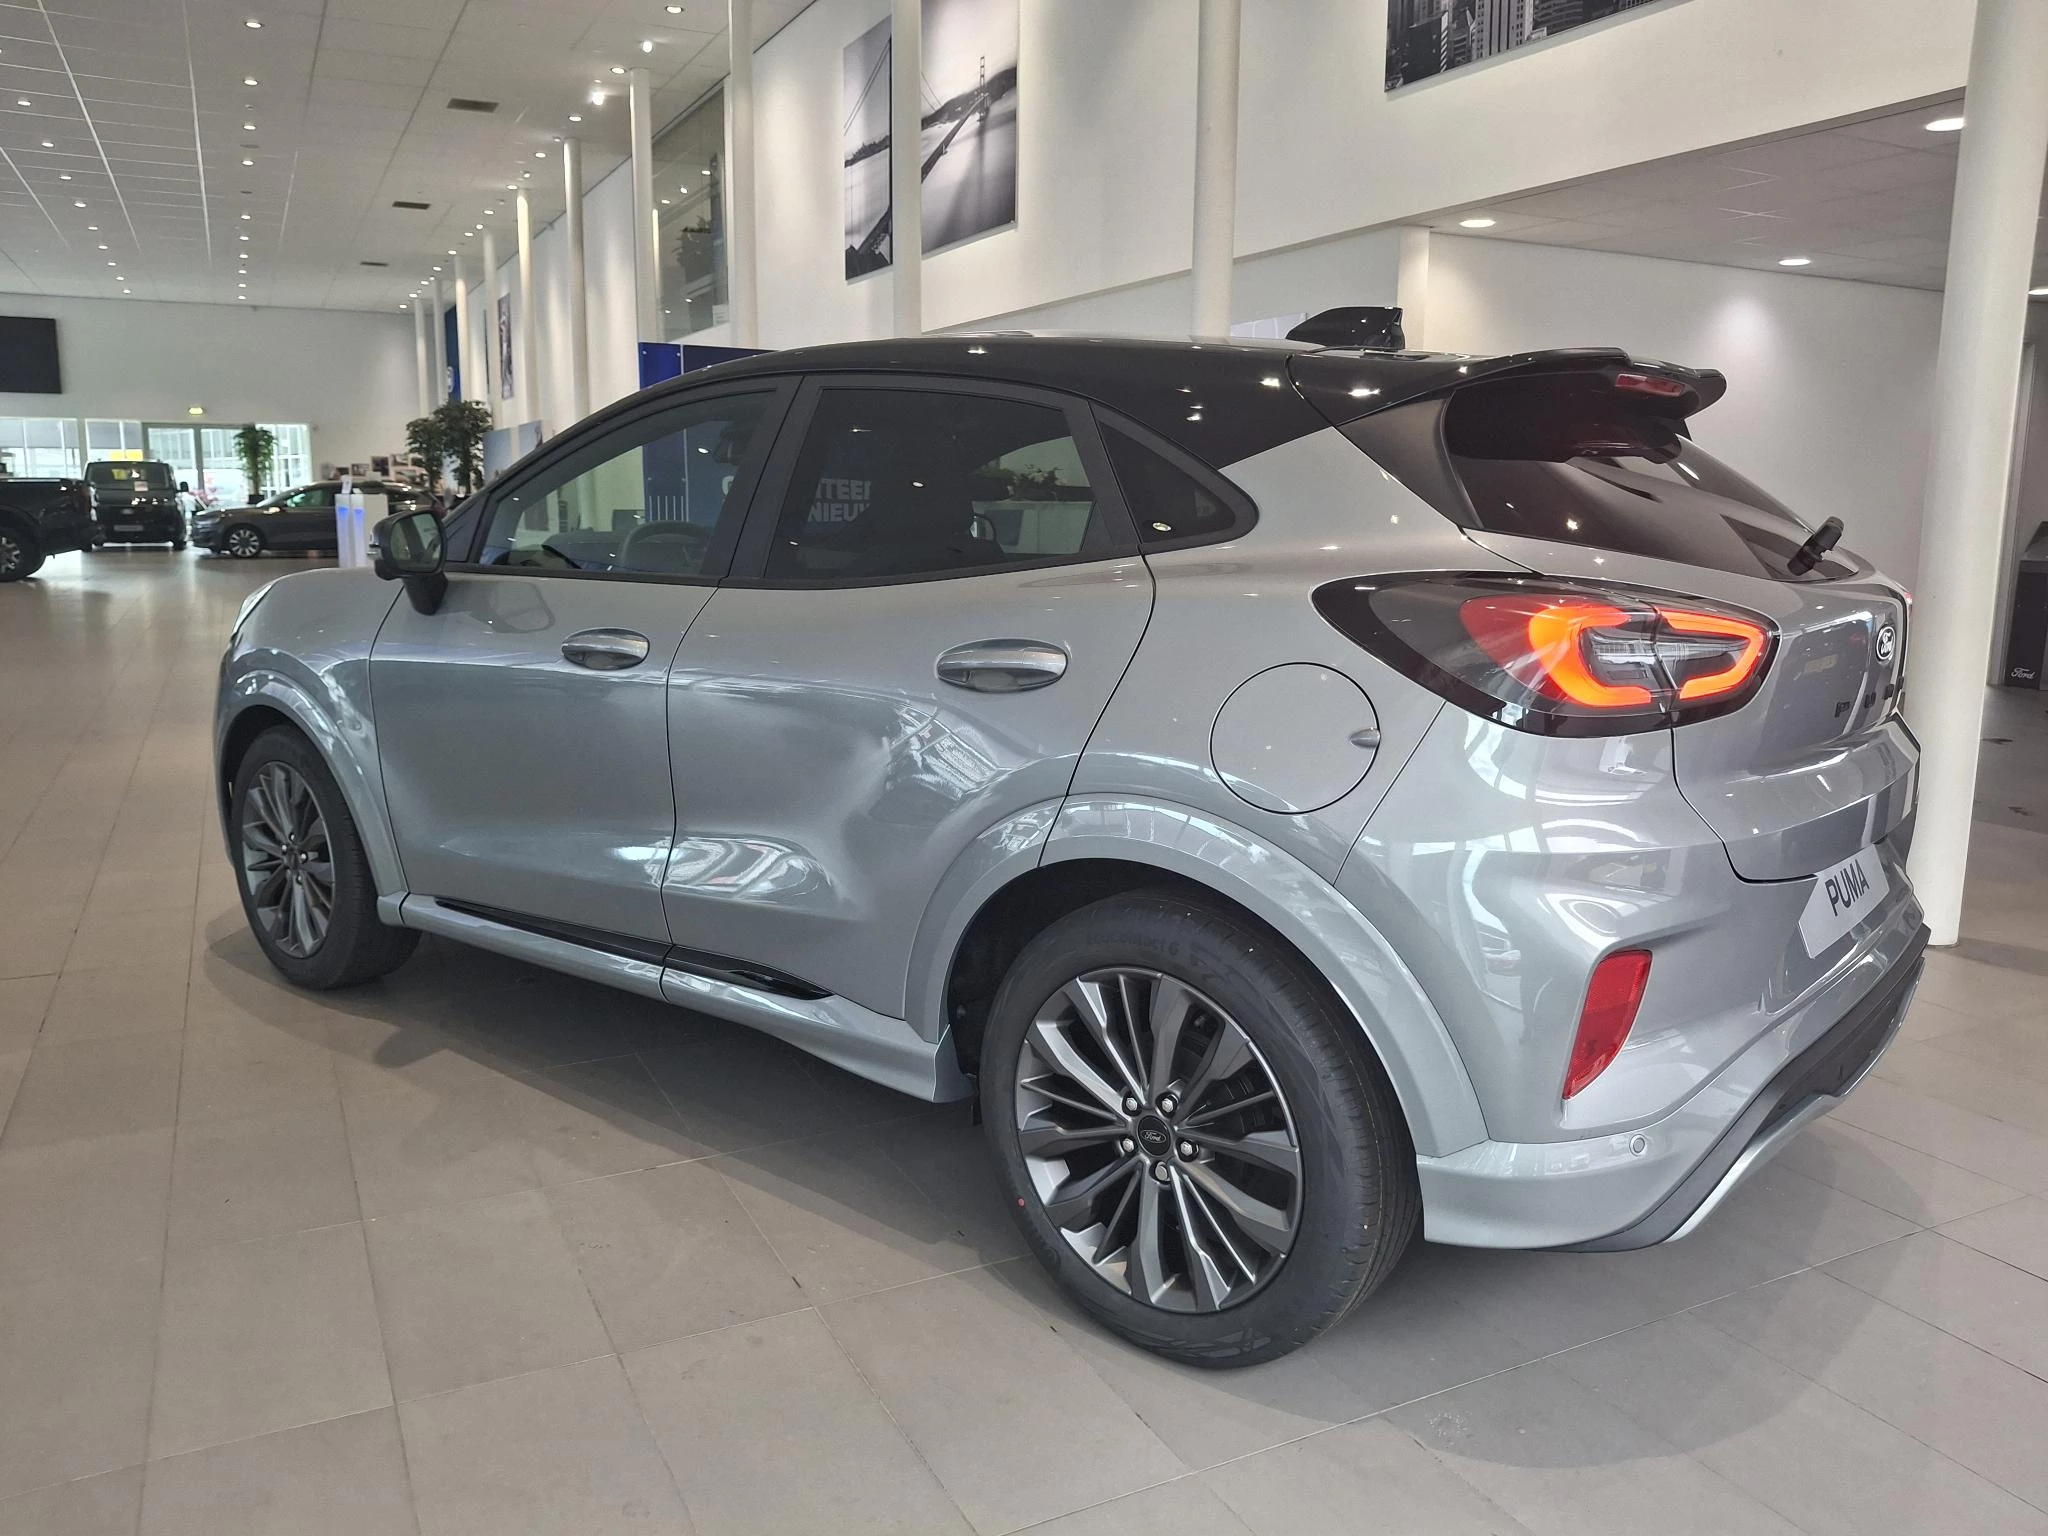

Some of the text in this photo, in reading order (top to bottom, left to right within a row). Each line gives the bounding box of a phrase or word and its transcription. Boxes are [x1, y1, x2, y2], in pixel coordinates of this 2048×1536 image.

[2010, 667, 2036, 680] Ford
[1825, 859, 1870, 917] PUMA
[1144, 1131, 1163, 1142] Ford
